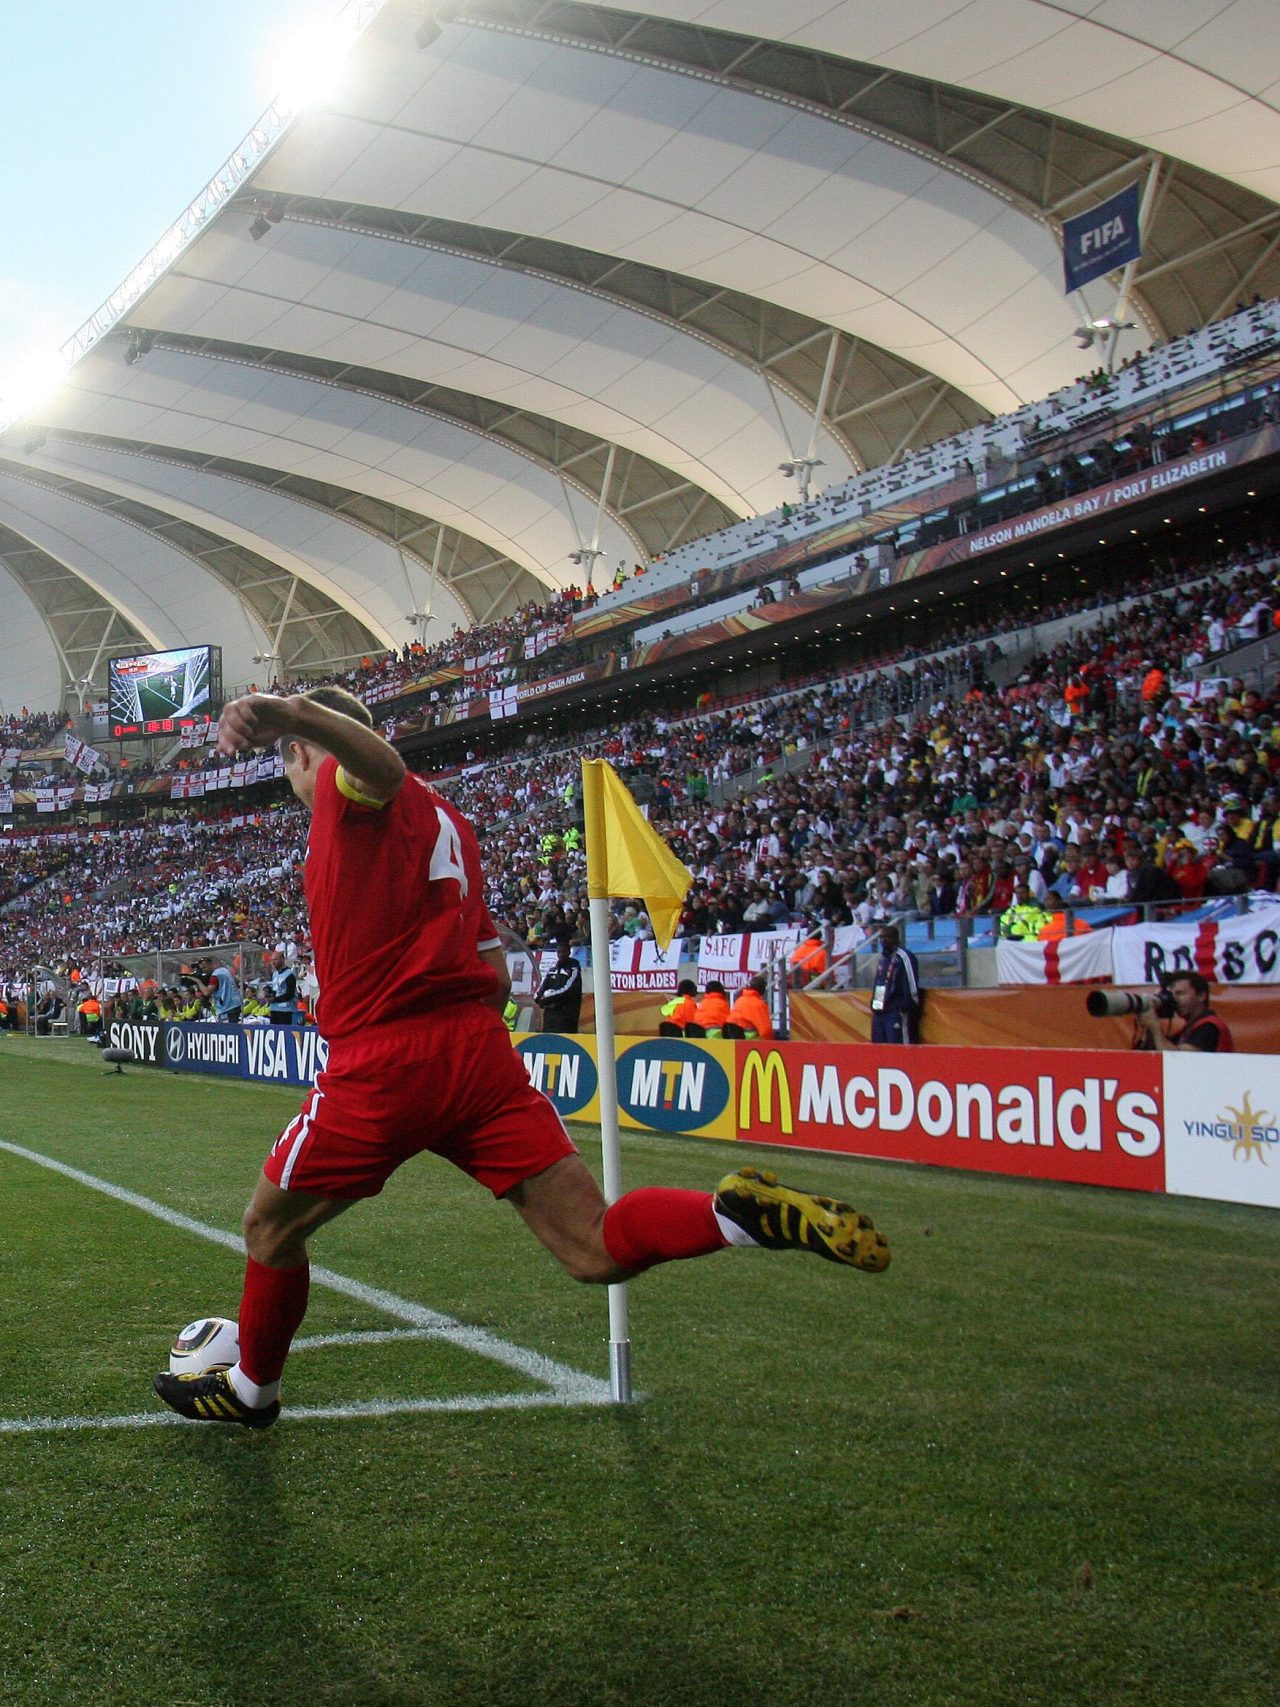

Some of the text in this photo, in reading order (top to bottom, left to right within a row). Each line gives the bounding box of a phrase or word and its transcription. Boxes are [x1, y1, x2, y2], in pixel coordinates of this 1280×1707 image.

[1080, 215, 1125, 255] FIFA
[970, 528, 1012, 552] NELSON
[1015, 508, 1071, 537] MANDELA
[1073, 496, 1100, 516] BAY
[1114, 479, 1148, 503] PORT
[1151, 450, 1227, 489] ELIZABETH
[535, 684, 547, 694] CUP
[547, 678, 566, 691] SOUTH
[429, 806, 468, 901] 4
[705, 937, 736, 957] SAFC
[610, 971, 676, 989] RTON BLADES
[110, 1022, 160, 1062] SONY
[187, 1032, 239, 1064] HYUNDAI
[244, 1028, 329, 1082] VISA VIS
[523, 1051, 580, 1098] MTN
[629, 1058, 706, 1112] MTN
[798, 1063, 1162, 1158] McDonald's
[1183, 1119, 1280, 1143] YINGLI SO
